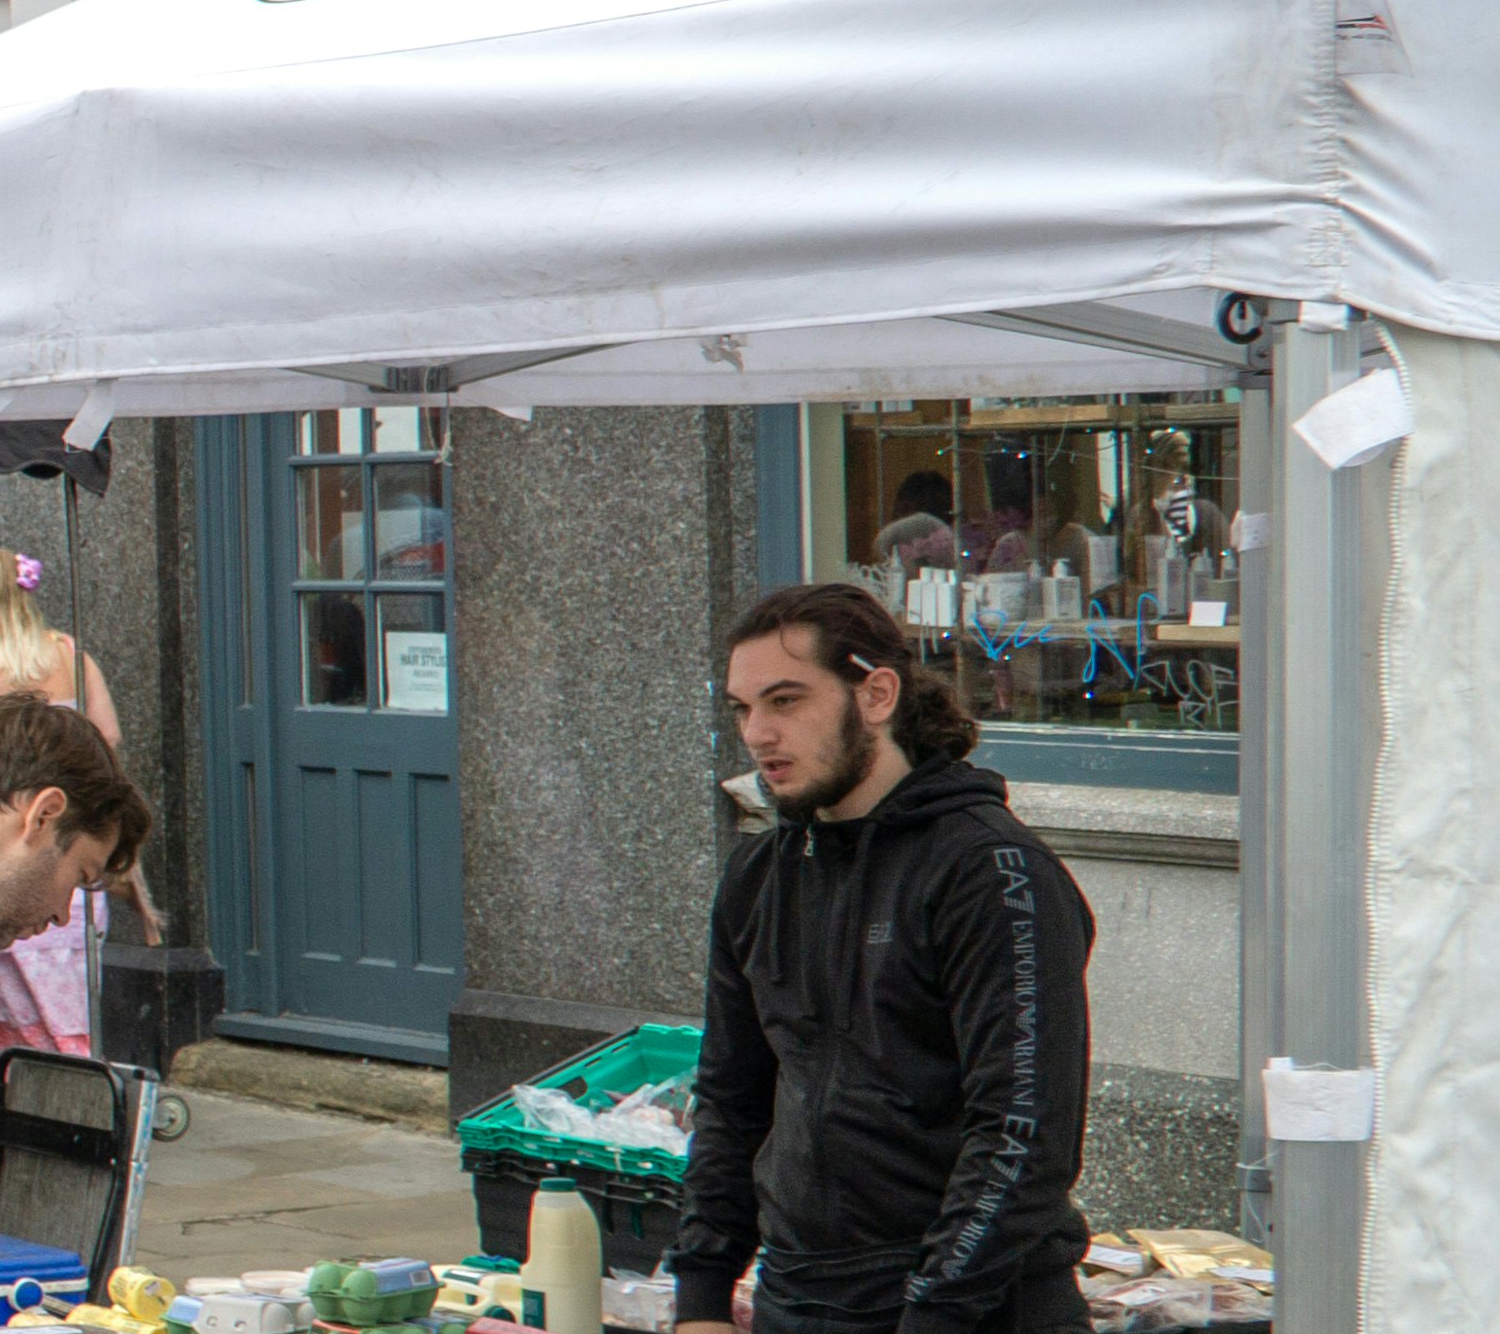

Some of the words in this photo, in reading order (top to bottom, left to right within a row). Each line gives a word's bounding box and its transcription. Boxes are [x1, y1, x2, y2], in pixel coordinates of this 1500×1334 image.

[993, 846, 1037, 917] EA7
[1011, 919, 1036, 1010] EMPORIO
[1011, 1031, 1036, 1107] ARMANI
[992, 1113, 1036, 1187] EA7
